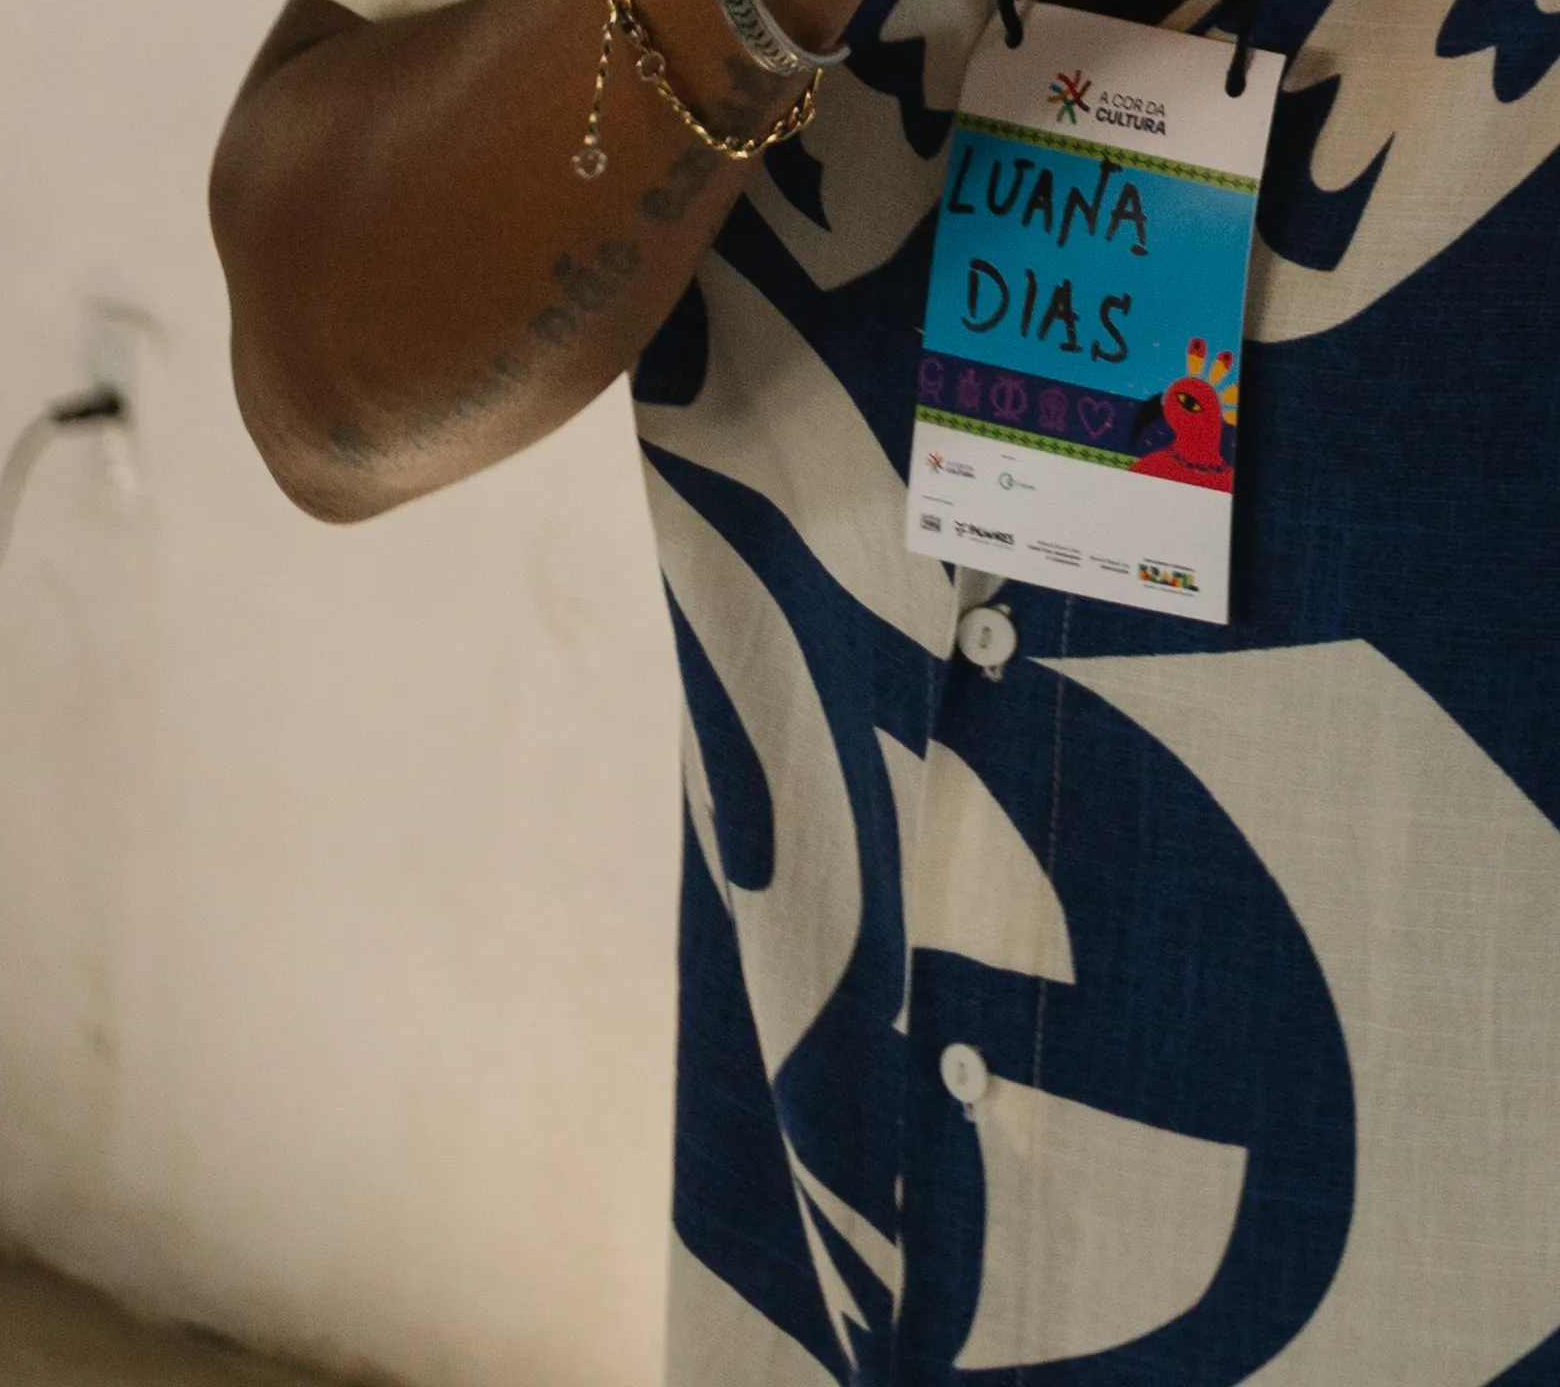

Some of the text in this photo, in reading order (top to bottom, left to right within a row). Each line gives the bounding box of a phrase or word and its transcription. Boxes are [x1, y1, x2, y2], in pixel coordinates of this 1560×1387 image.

[1095, 107, 1167, 136] CULTURA
[947, 144, 1149, 257] LUANA
[961, 258, 1133, 364] DIAS
